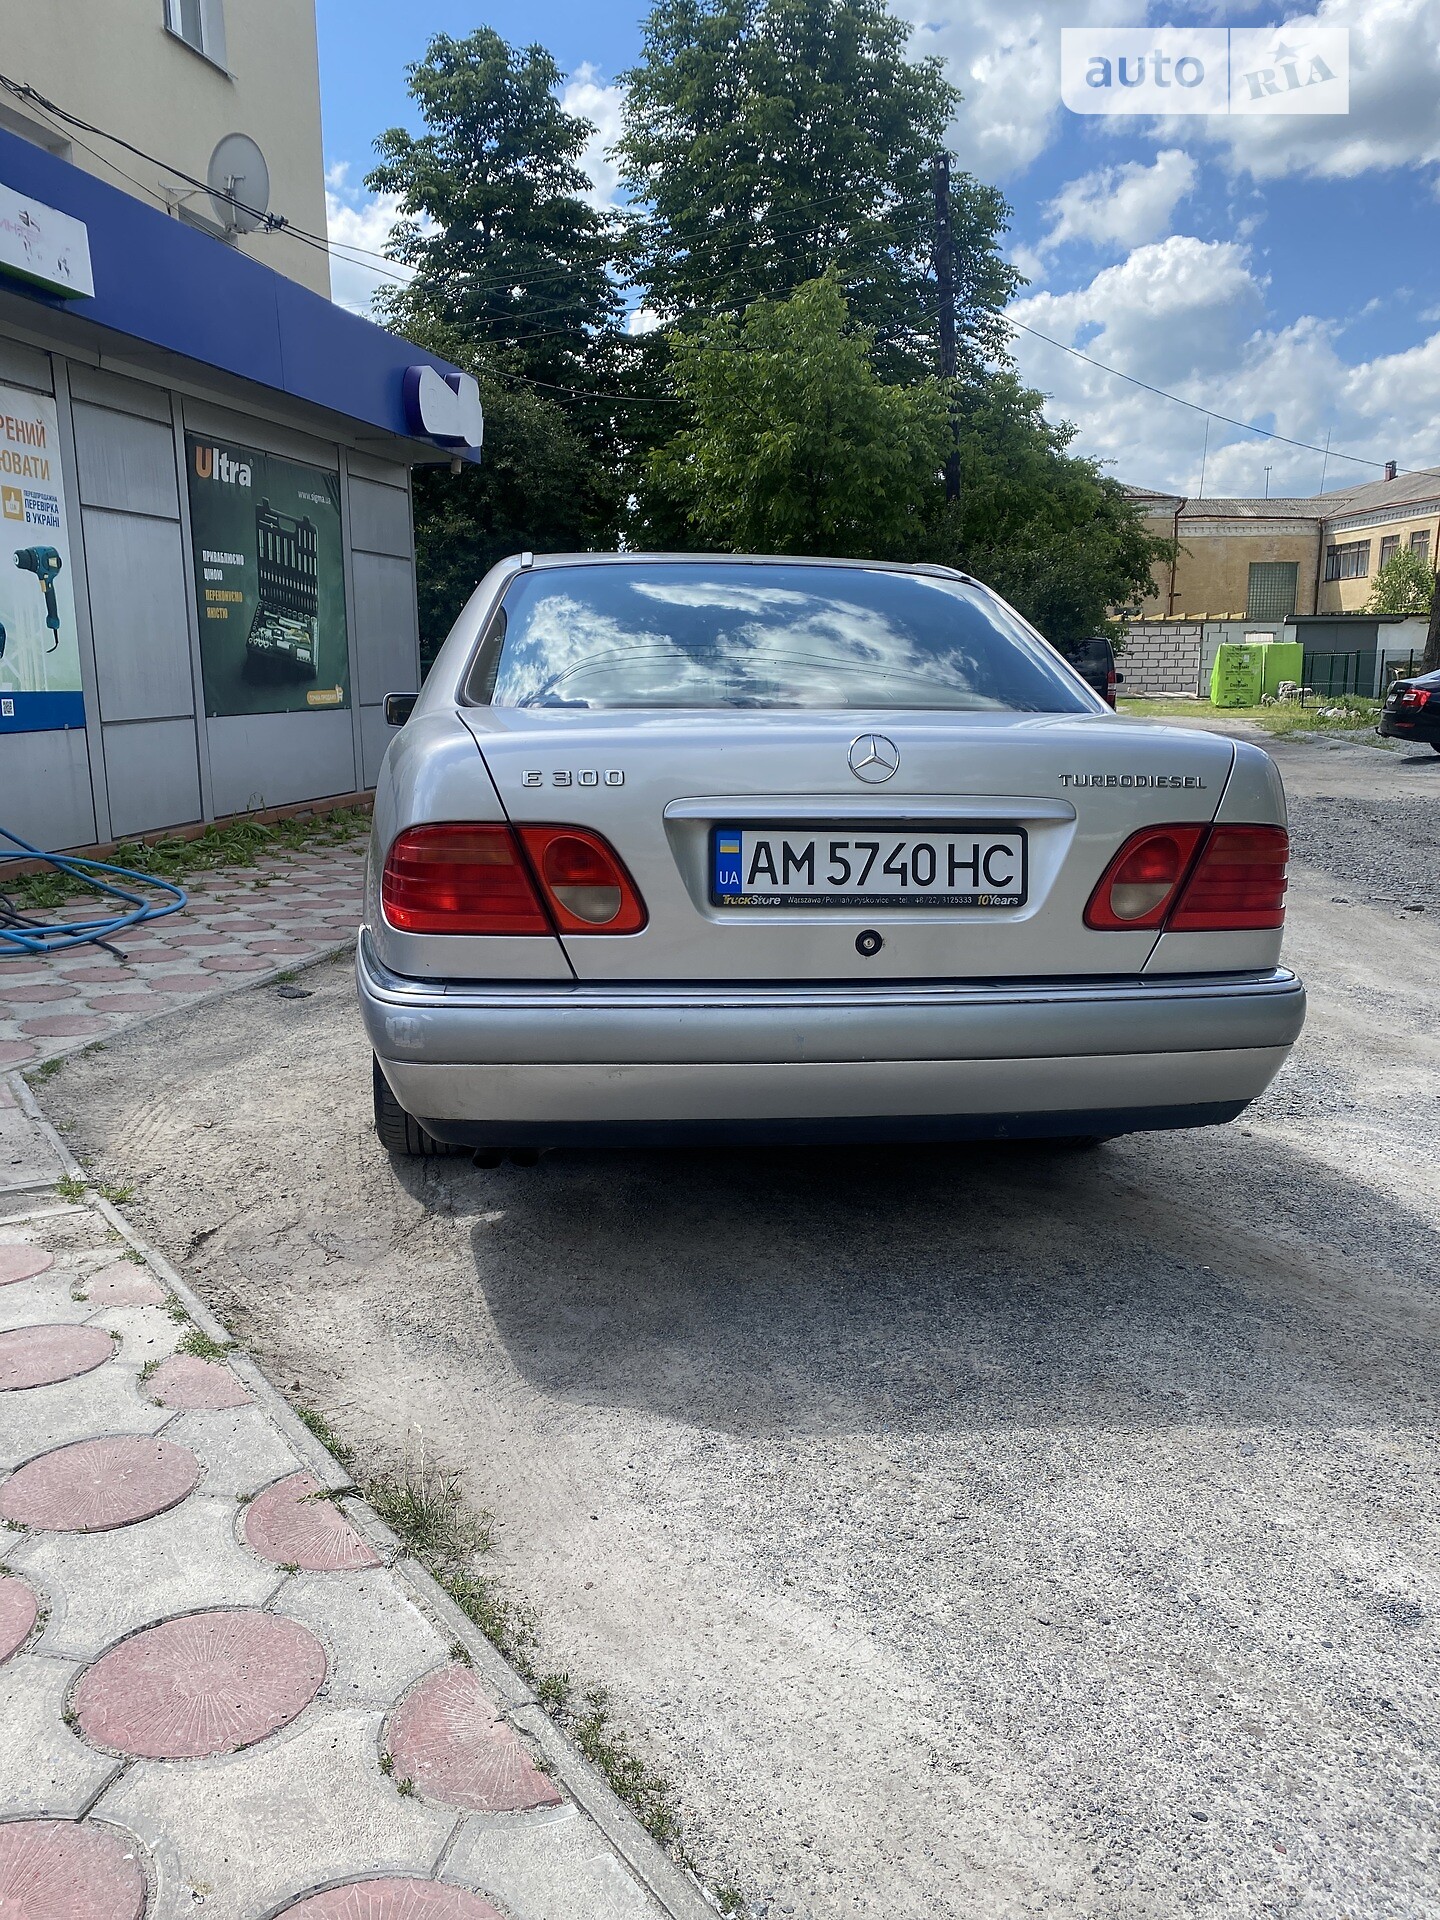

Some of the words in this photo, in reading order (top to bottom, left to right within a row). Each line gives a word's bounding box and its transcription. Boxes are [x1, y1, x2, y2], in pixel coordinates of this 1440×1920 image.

[195, 445, 252, 487] Ultra
[25, 499, 59, 514] ПЕРЕВІРКА
[26, 511, 31, 523] В
[32, 512, 60, 528] УКРАЇНІ
[521, 769, 543, 787] E
[552, 769, 625, 787] 300
[1058, 774, 1207, 789] TURBODIESEL
[747, 841, 815, 886] AM
[826, 842, 937, 887] 5740
[948, 843, 1015, 888] HC
[719, 871, 739, 885] UA
[722, 894, 781, 905] TruckStore
